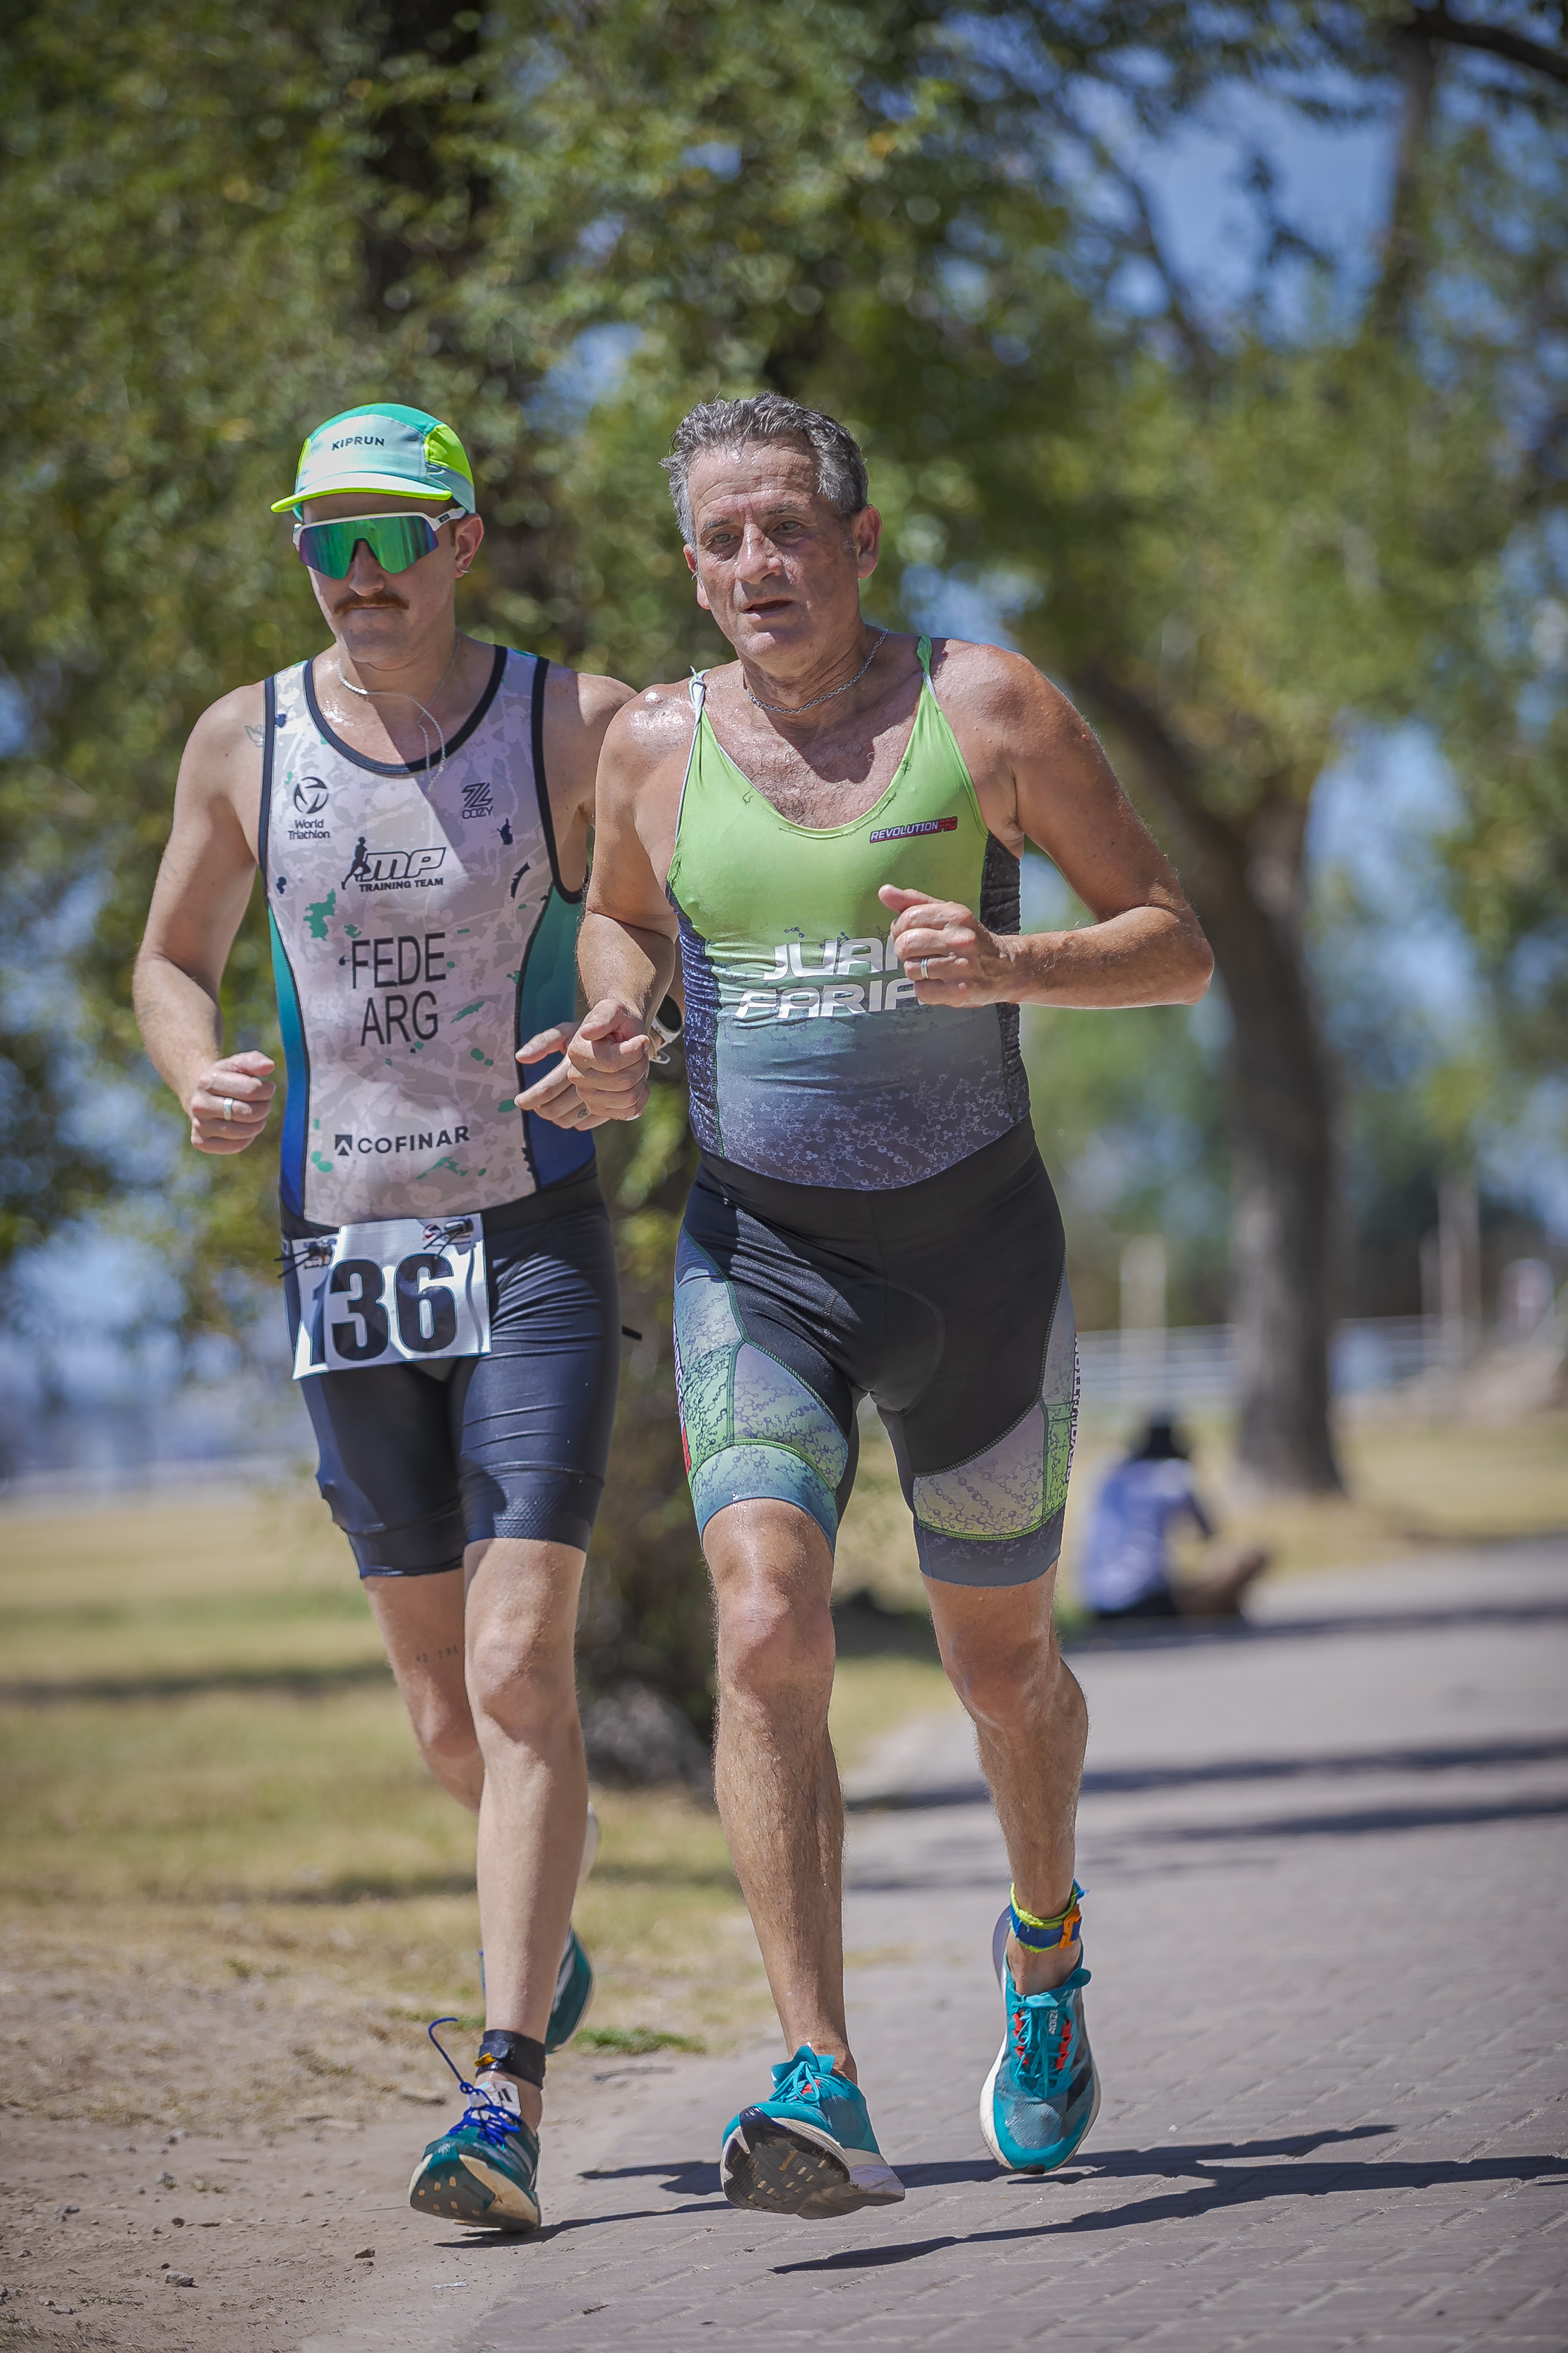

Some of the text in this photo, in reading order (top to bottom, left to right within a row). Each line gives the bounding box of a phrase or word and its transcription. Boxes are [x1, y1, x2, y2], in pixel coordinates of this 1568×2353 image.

[332, 436, 385, 451] KIPRUN
[294, 819, 324, 829] World
[287, 830, 330, 840] Triathlon
[359, 878, 443, 893] TRAINING TEAM
[352, 931, 446, 989] FEDE
[361, 990, 438, 1047] ARG
[358, 1125, 471, 1155] COFINAR
